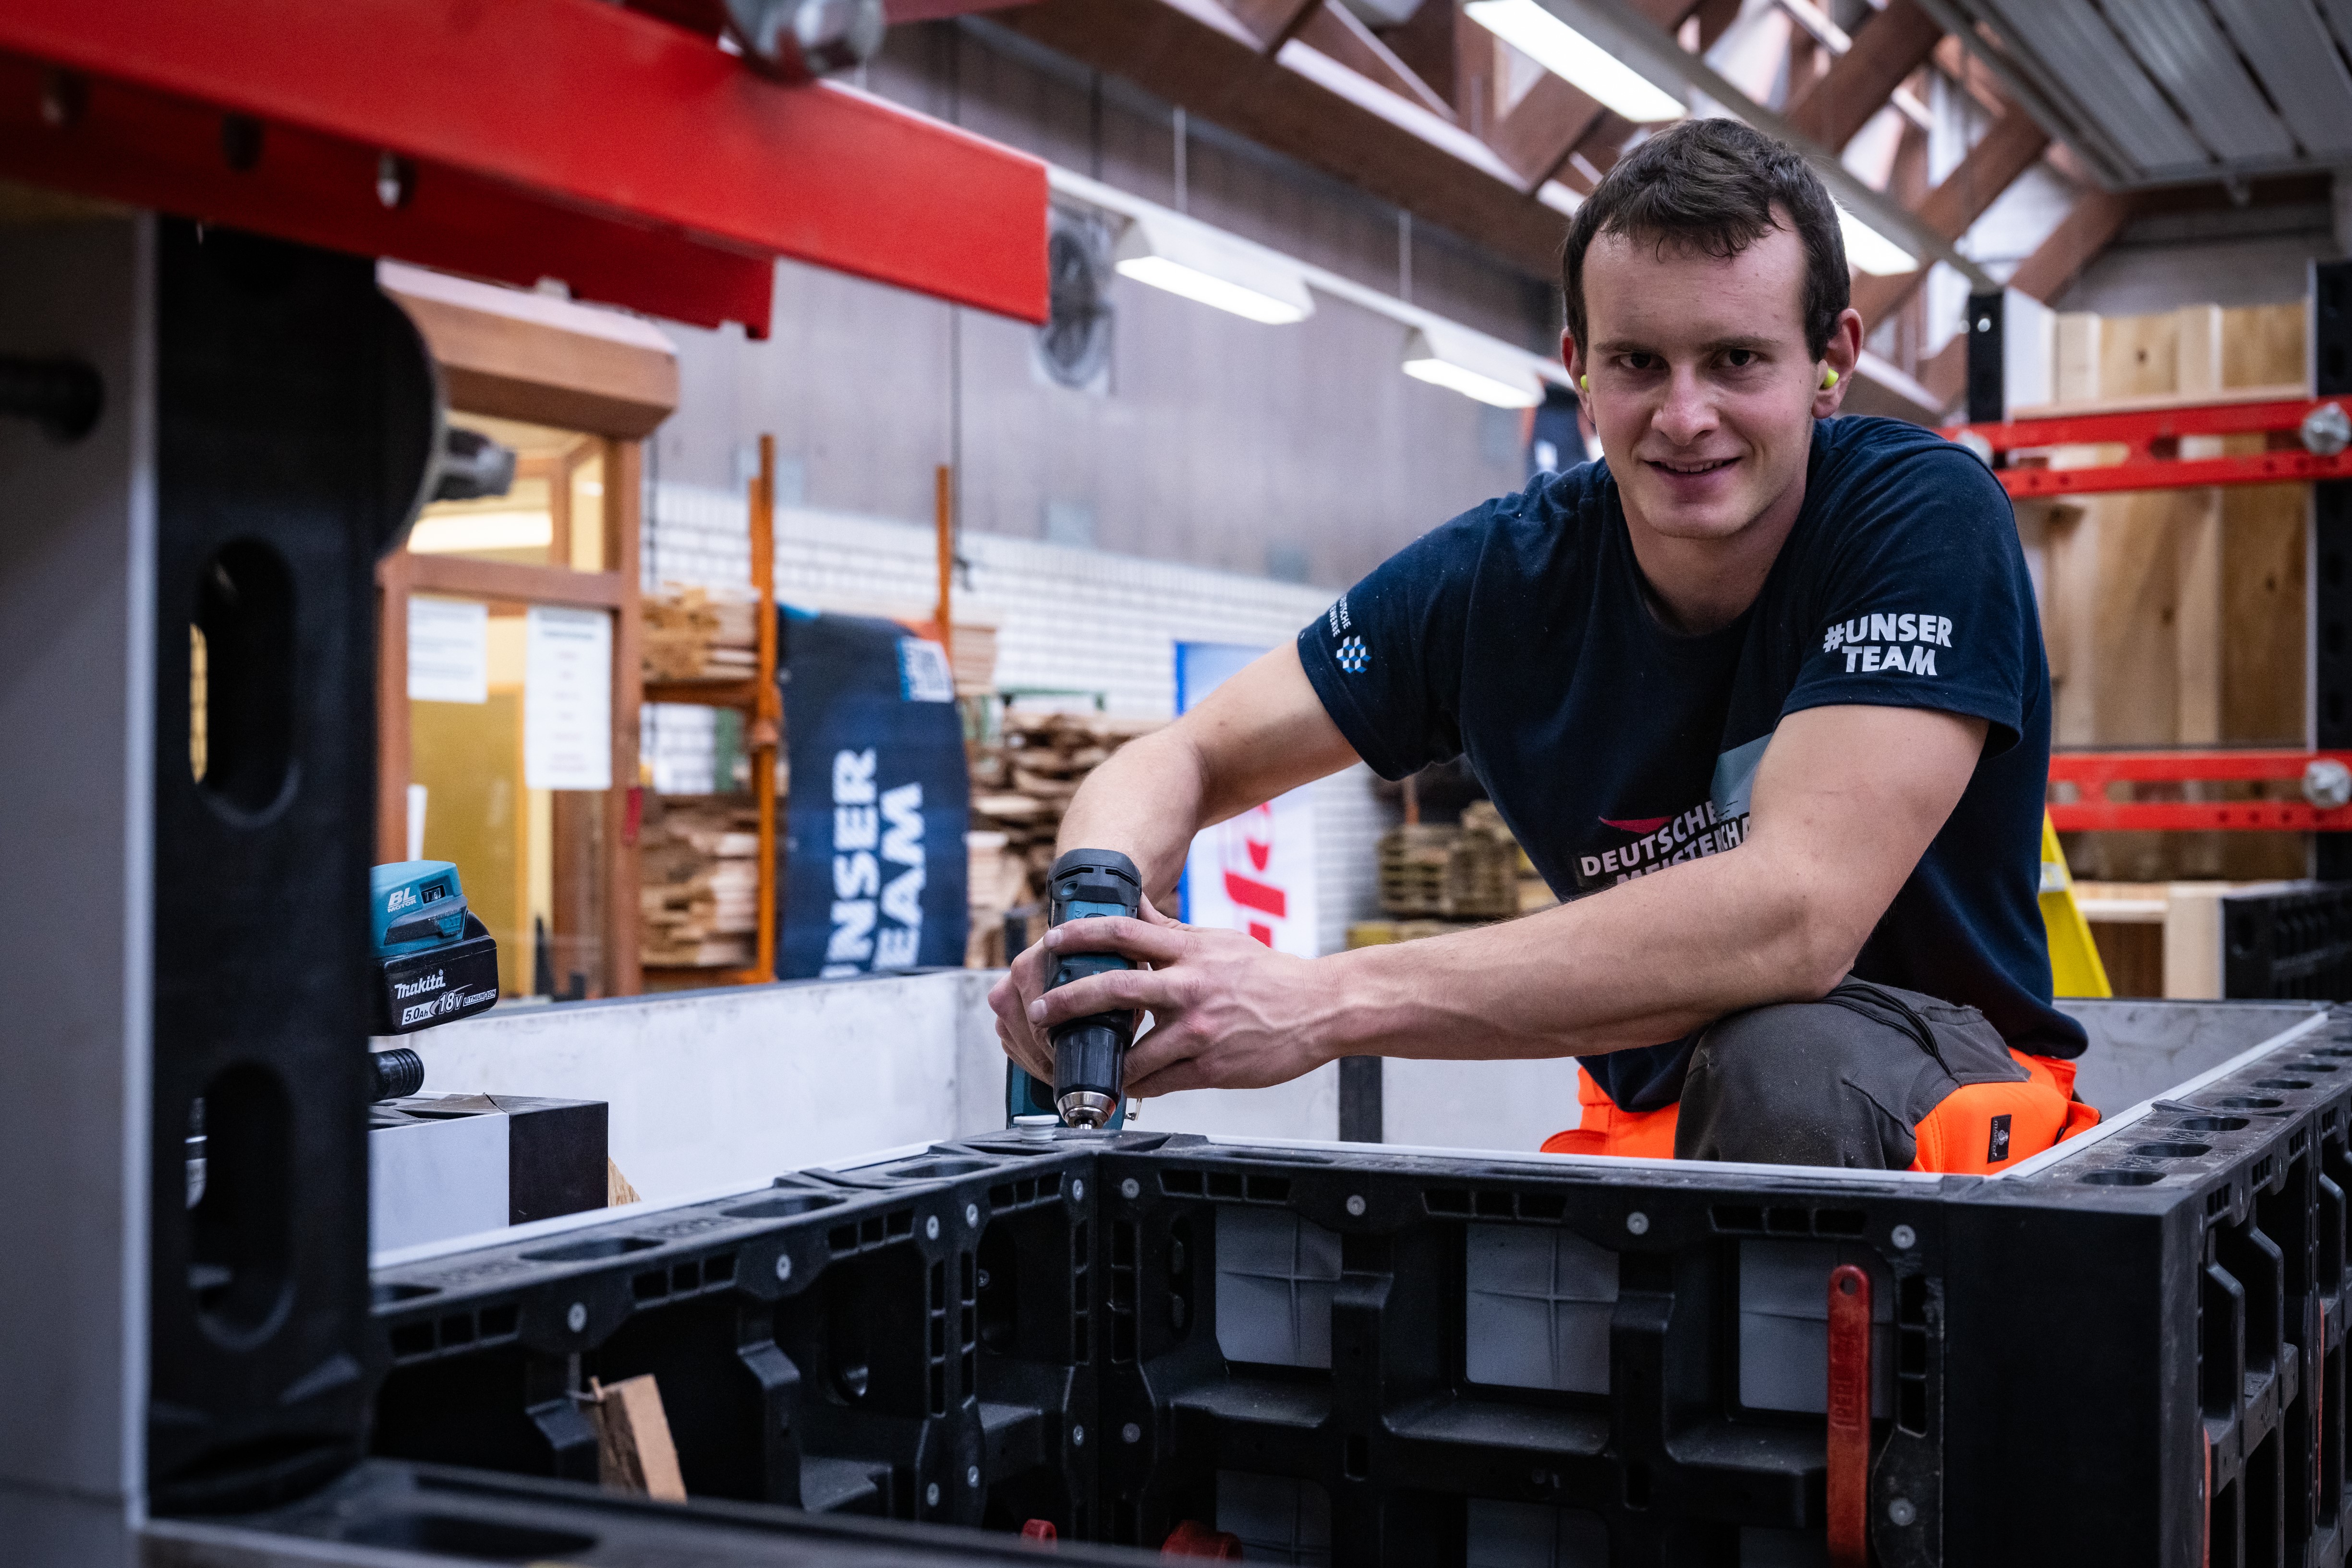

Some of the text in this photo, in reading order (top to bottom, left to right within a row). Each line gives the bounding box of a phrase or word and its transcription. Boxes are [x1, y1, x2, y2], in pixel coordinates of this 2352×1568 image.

[1823, 614, 1952, 653] #UNSER
[1842, 645, 1938, 676] TEAM
[1581, 800, 1718, 877] DEUTSCHE
[388, 887, 416, 908] BL
[388, 900, 417, 913] MOTOR
[405, 989, 497, 1023] 5.0Ah 18V LITHIUM-ION
